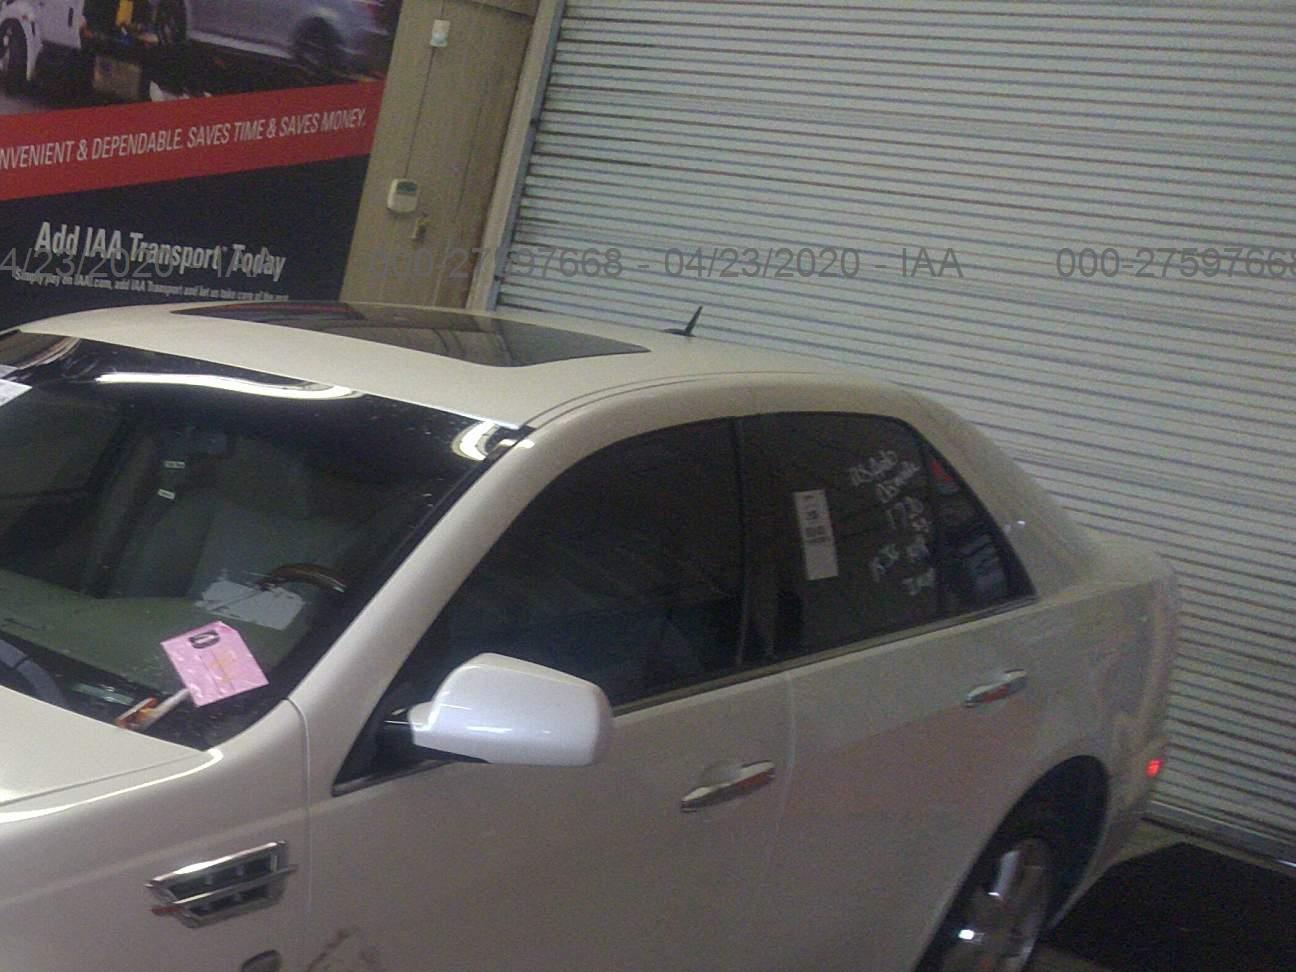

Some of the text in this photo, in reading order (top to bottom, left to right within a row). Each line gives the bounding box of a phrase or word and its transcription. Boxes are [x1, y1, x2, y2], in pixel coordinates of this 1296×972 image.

[77, 143, 88, 160] &
[187, 122, 230, 149] SAVES
[233, 119, 264, 141] TIME
[266, 118, 276, 138] &
[279, 112, 318, 137] SAVES
[320, 108, 366, 131] MONEY.
[34, 222, 79, 257] Add
[84, 227, 122, 260] IAA
[232, 243, 286, 282] Today
